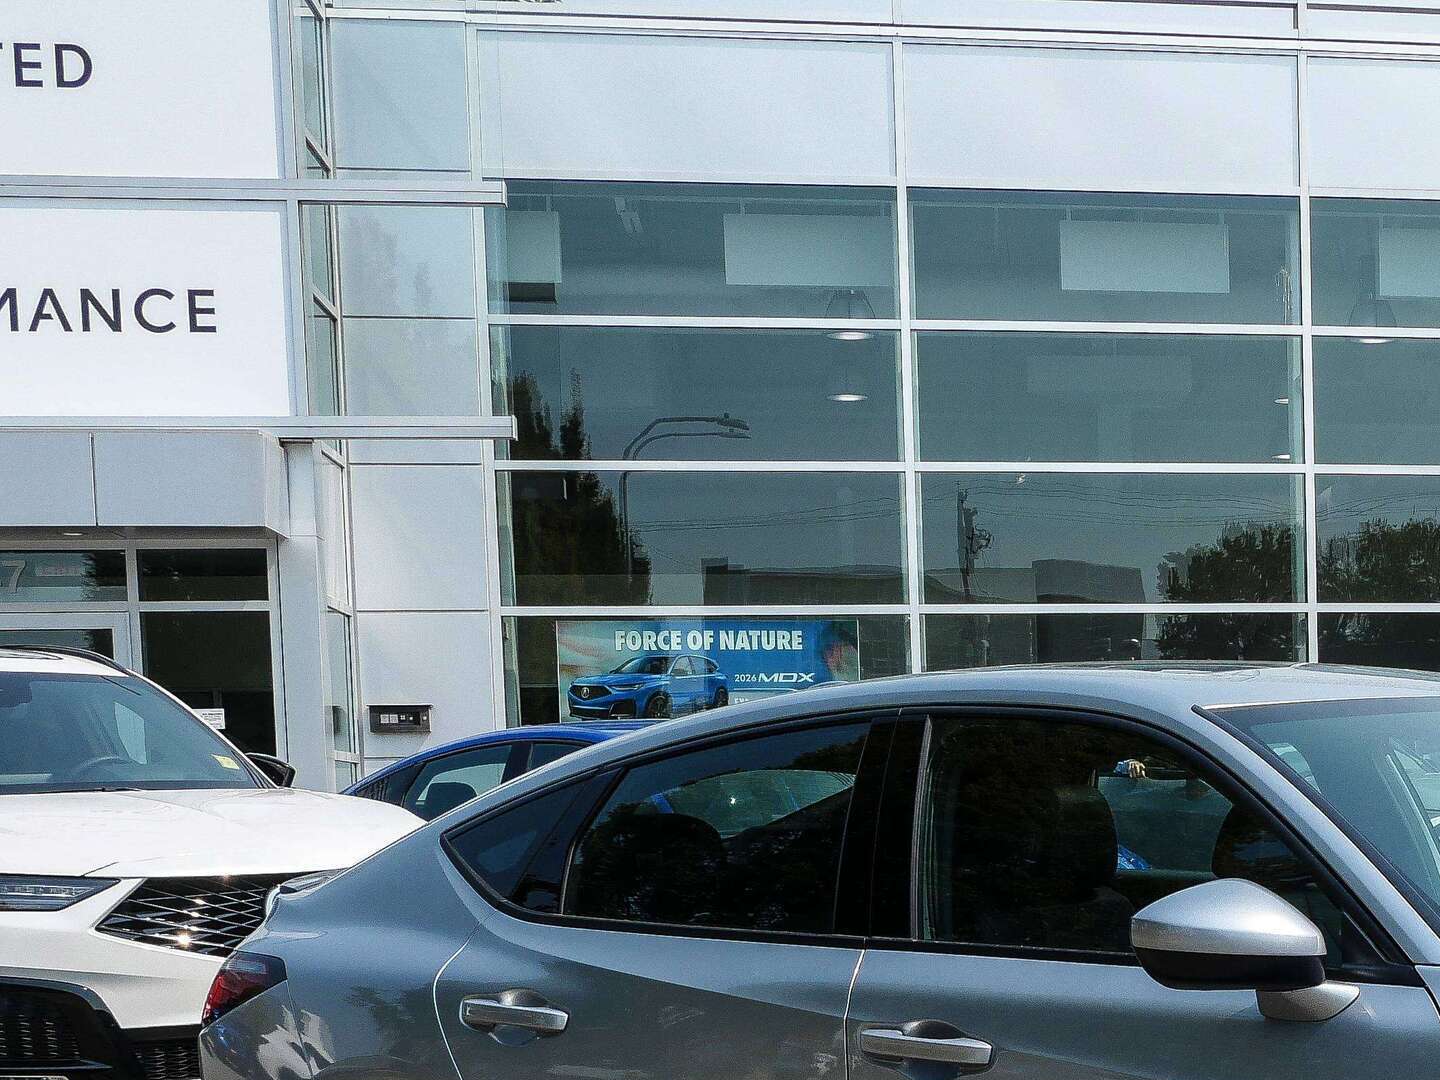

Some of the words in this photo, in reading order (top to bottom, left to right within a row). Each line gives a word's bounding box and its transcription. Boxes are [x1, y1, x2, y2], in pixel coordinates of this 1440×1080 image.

[0, 43, 93, 88] ED
[614, 630, 682, 651] FORCE
[686, 630, 714, 651] OF
[719, 630, 803, 651] NATURE
[734, 674, 757, 682] 2026
[758, 672, 815, 682] MDX
